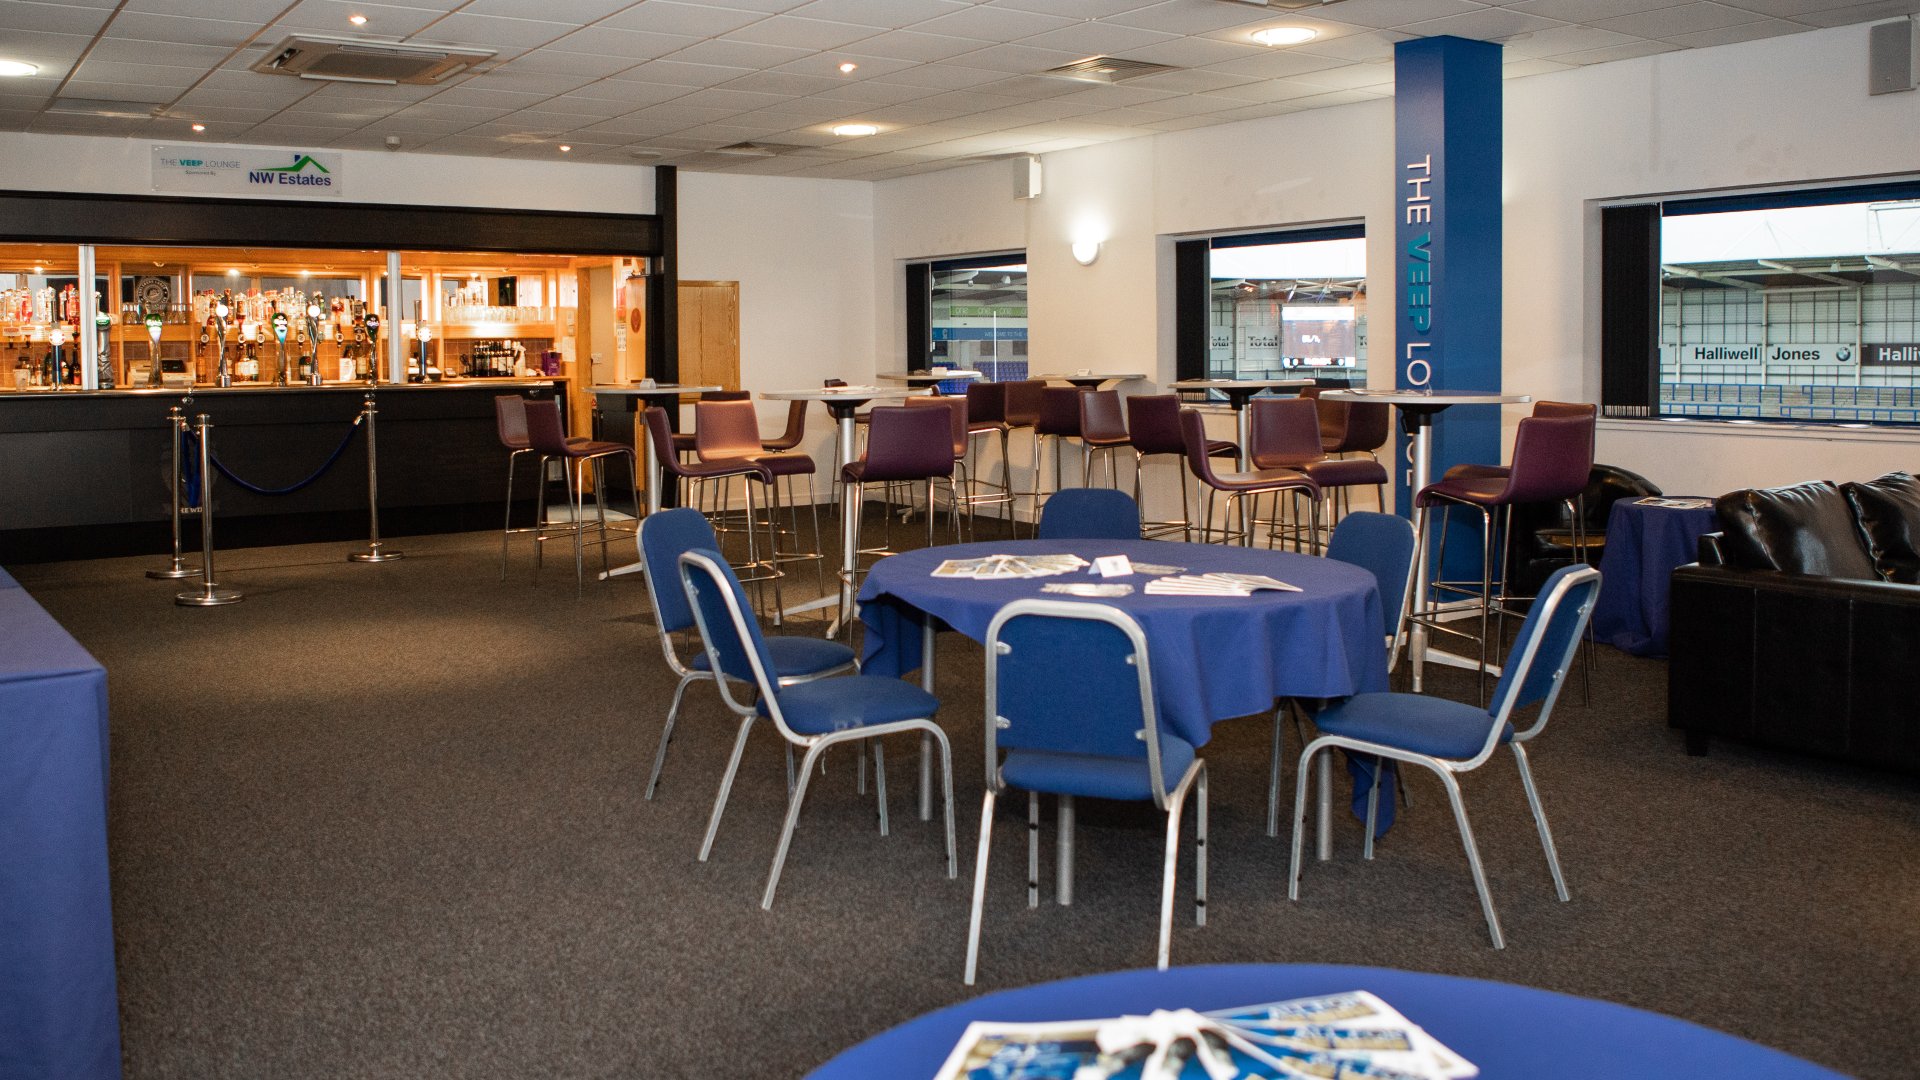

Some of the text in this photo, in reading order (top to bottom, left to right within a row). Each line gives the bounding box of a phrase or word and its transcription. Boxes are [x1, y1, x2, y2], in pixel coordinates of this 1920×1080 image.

[160, 158, 241, 169] THE VEEP LOUNGE
[250, 171, 331, 186] NW Estates
[1406, 154, 1431, 225] THE
[1407, 231, 1432, 334] VEEP
[1210, 336, 1229, 347] otal
[1248, 335, 1278, 347] Total
[1695, 347, 1820, 360] Halliwell Jones
